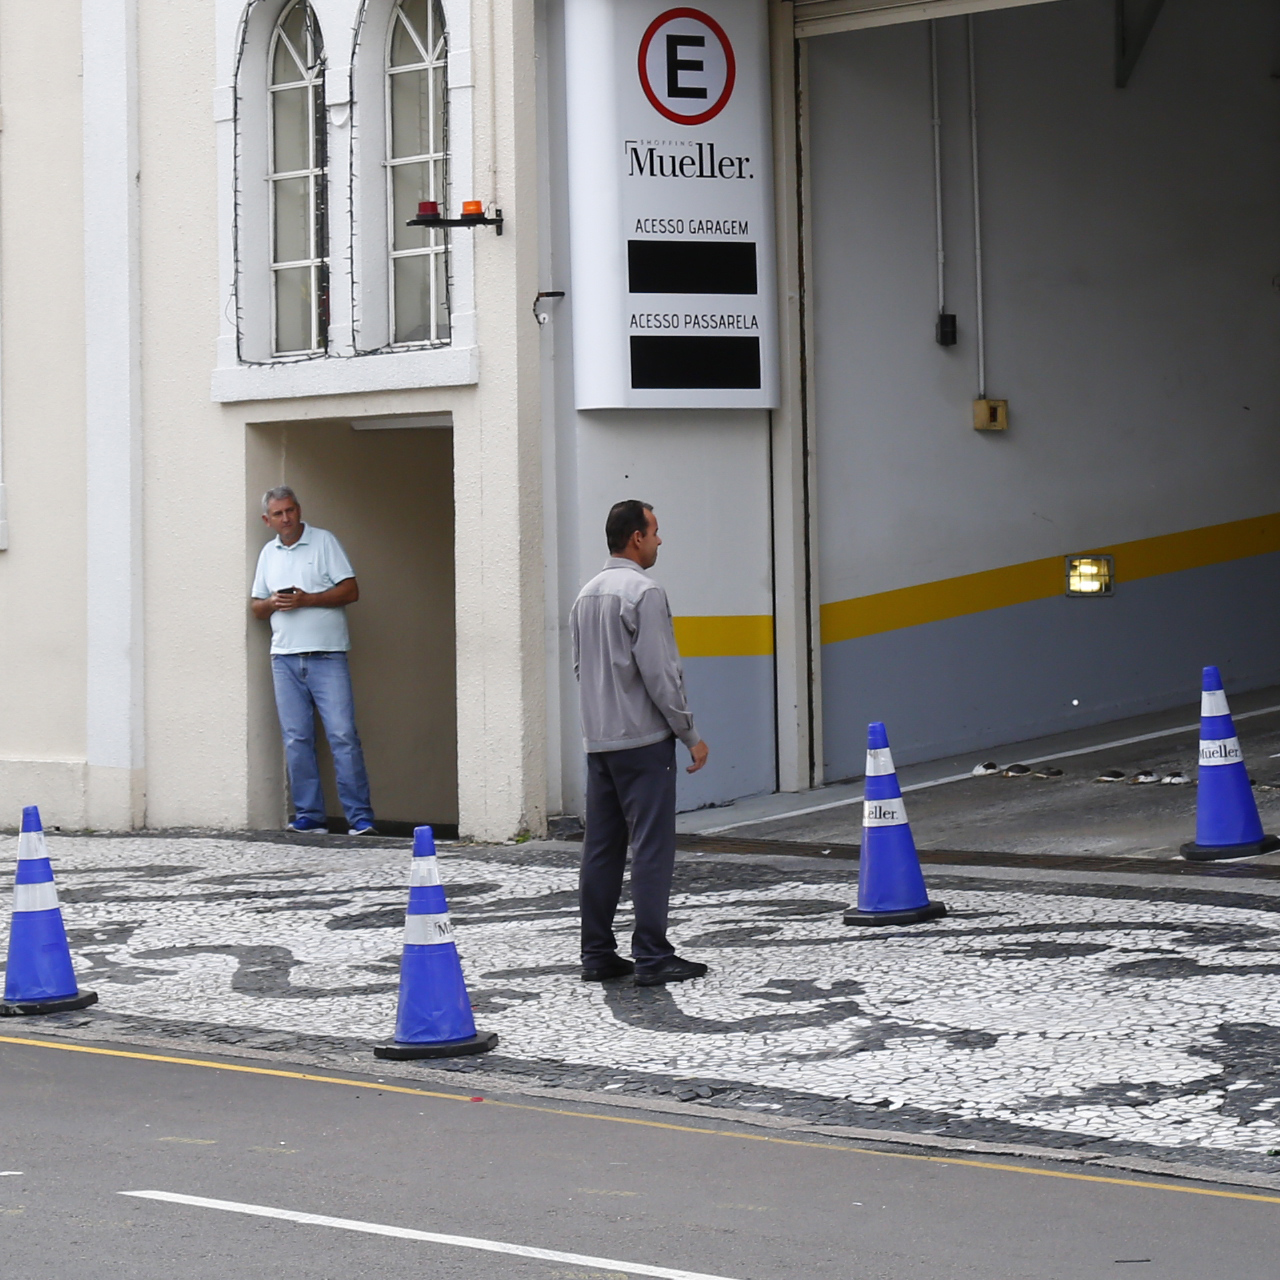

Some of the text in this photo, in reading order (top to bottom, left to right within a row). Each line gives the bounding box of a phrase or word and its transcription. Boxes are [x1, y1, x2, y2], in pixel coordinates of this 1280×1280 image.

[665, 34, 708, 99] E
[639, 139, 694, 147] SHOPPING
[635, 218, 749, 235] ACESSO GARAGEM
[629, 313, 759, 329] ACESSO PASSARELA
